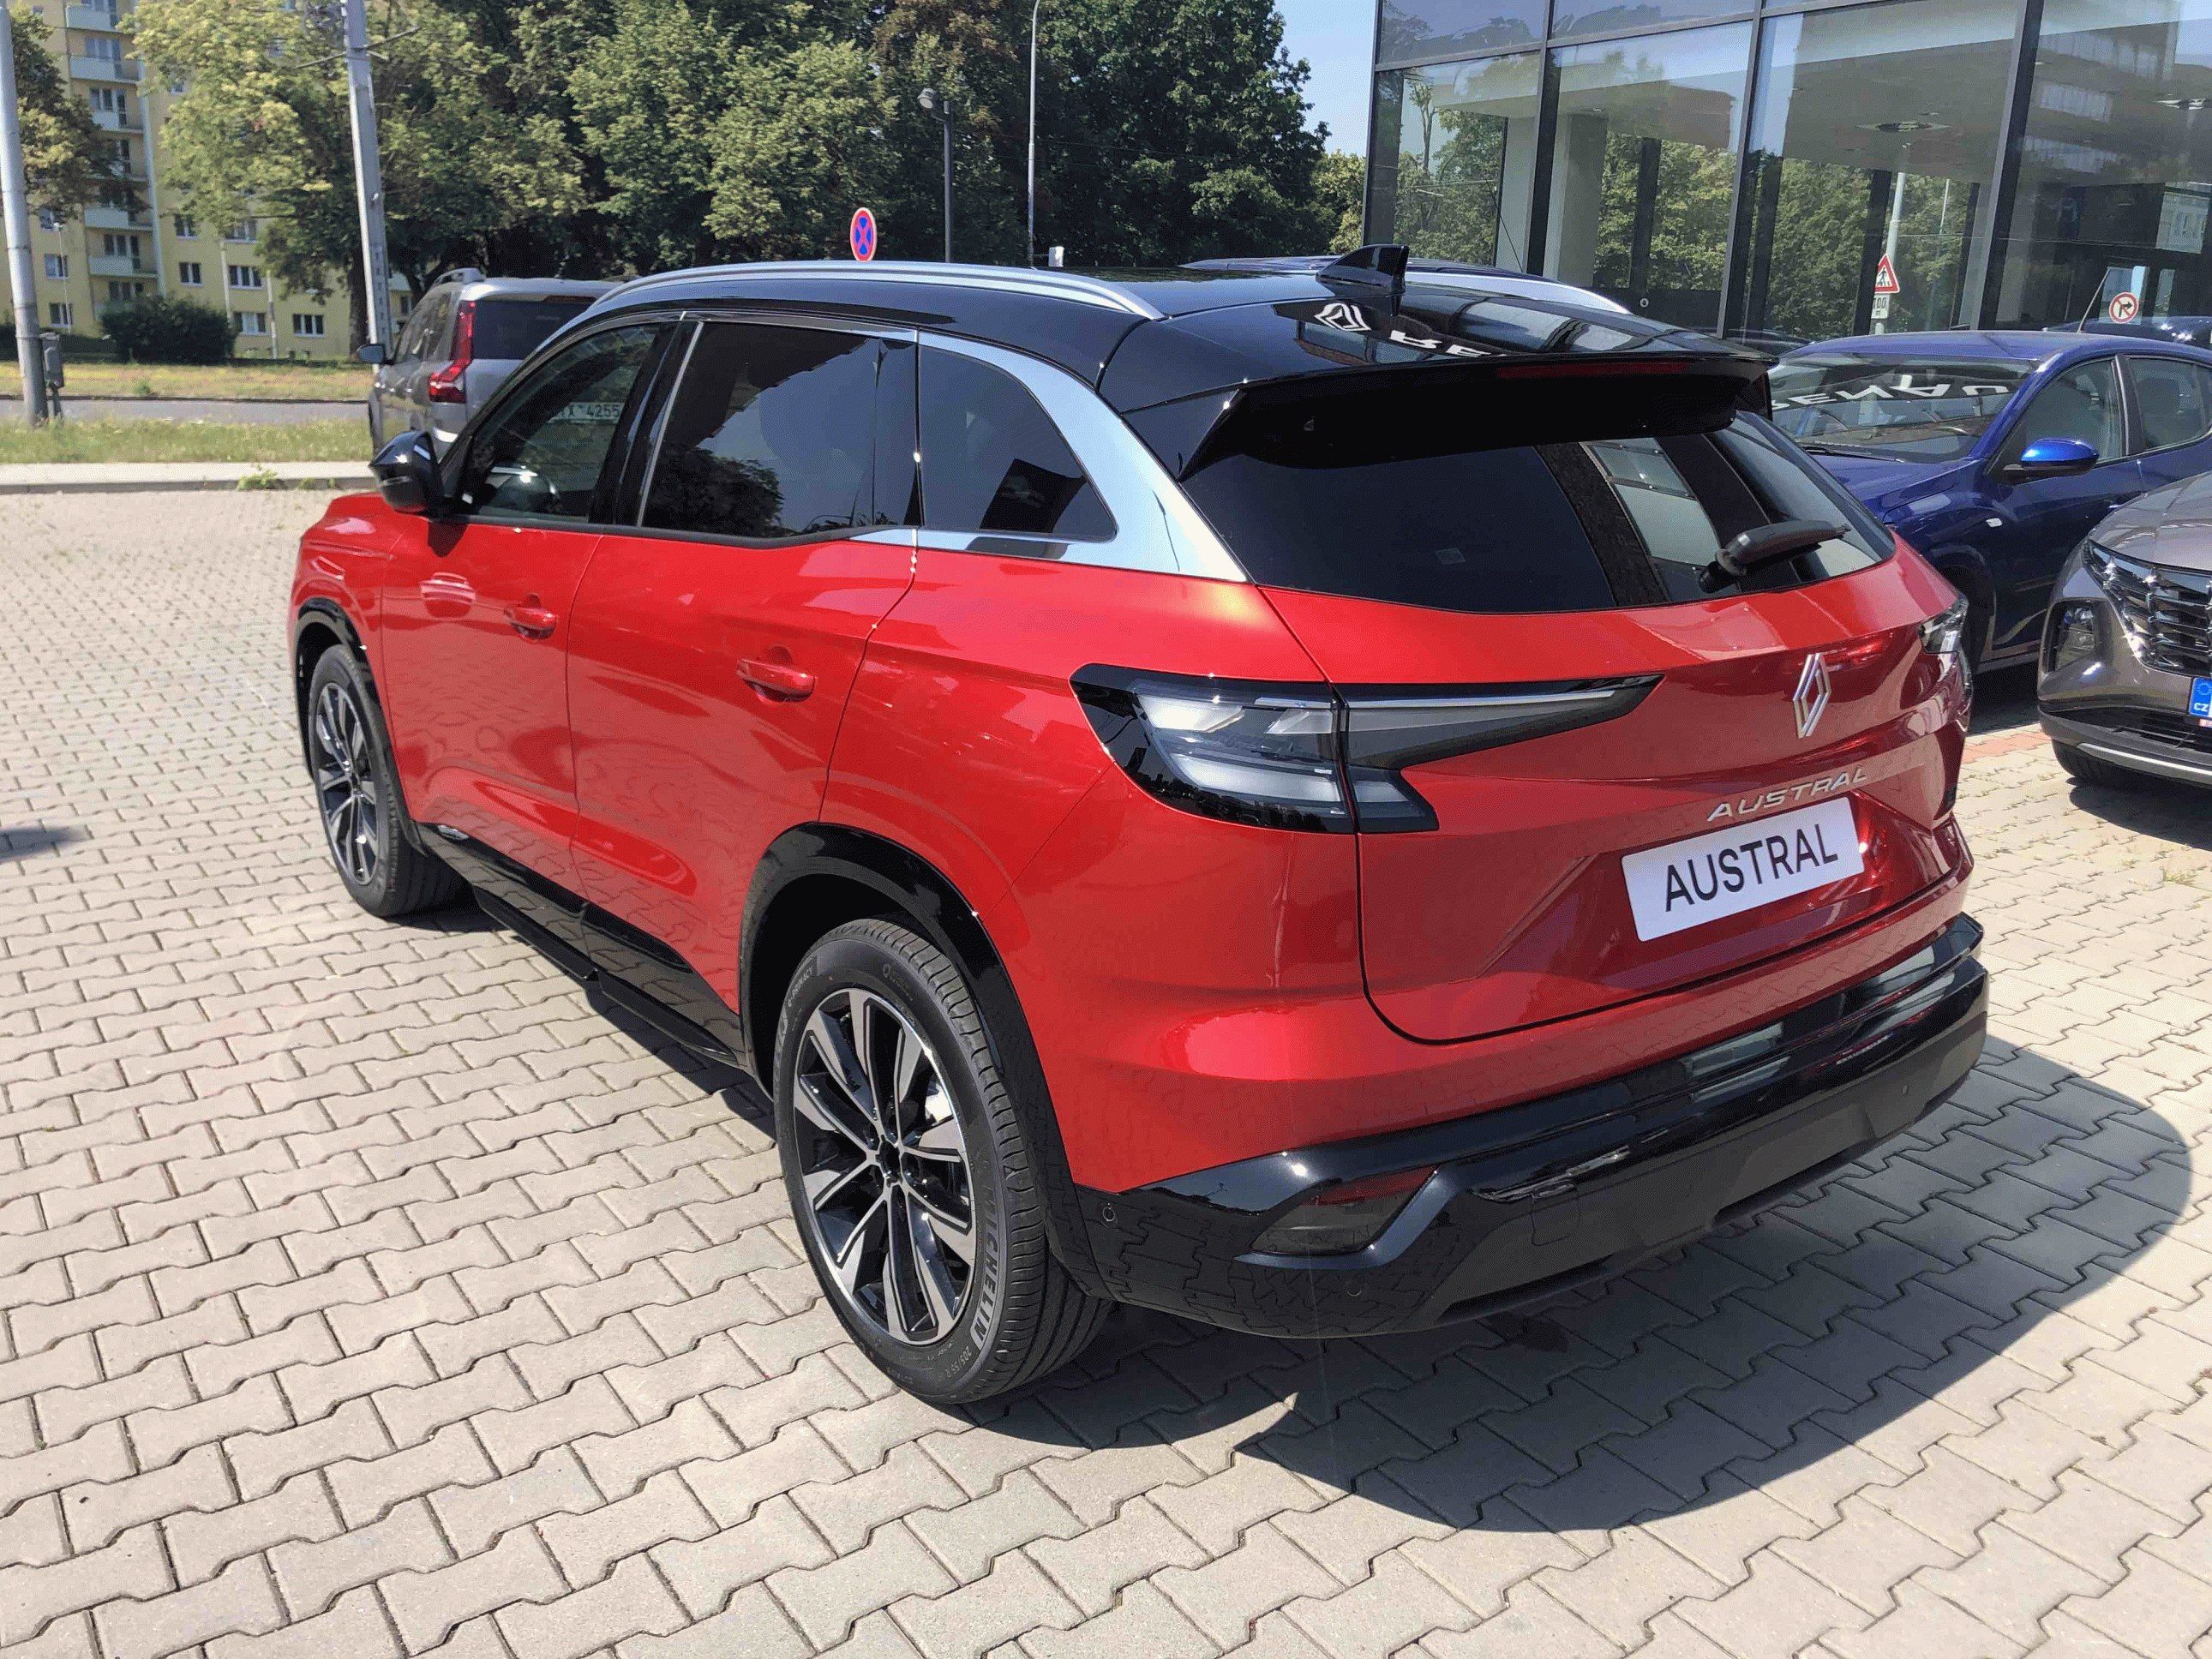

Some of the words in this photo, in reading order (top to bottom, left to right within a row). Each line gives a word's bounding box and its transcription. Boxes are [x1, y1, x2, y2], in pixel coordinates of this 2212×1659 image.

[586, 404, 620, 417] 4255
[2194, 702, 2209, 712] CZ
[1707, 767, 1869, 822] AUSTRAL
[1665, 824, 1838, 912] AUSTRAL
